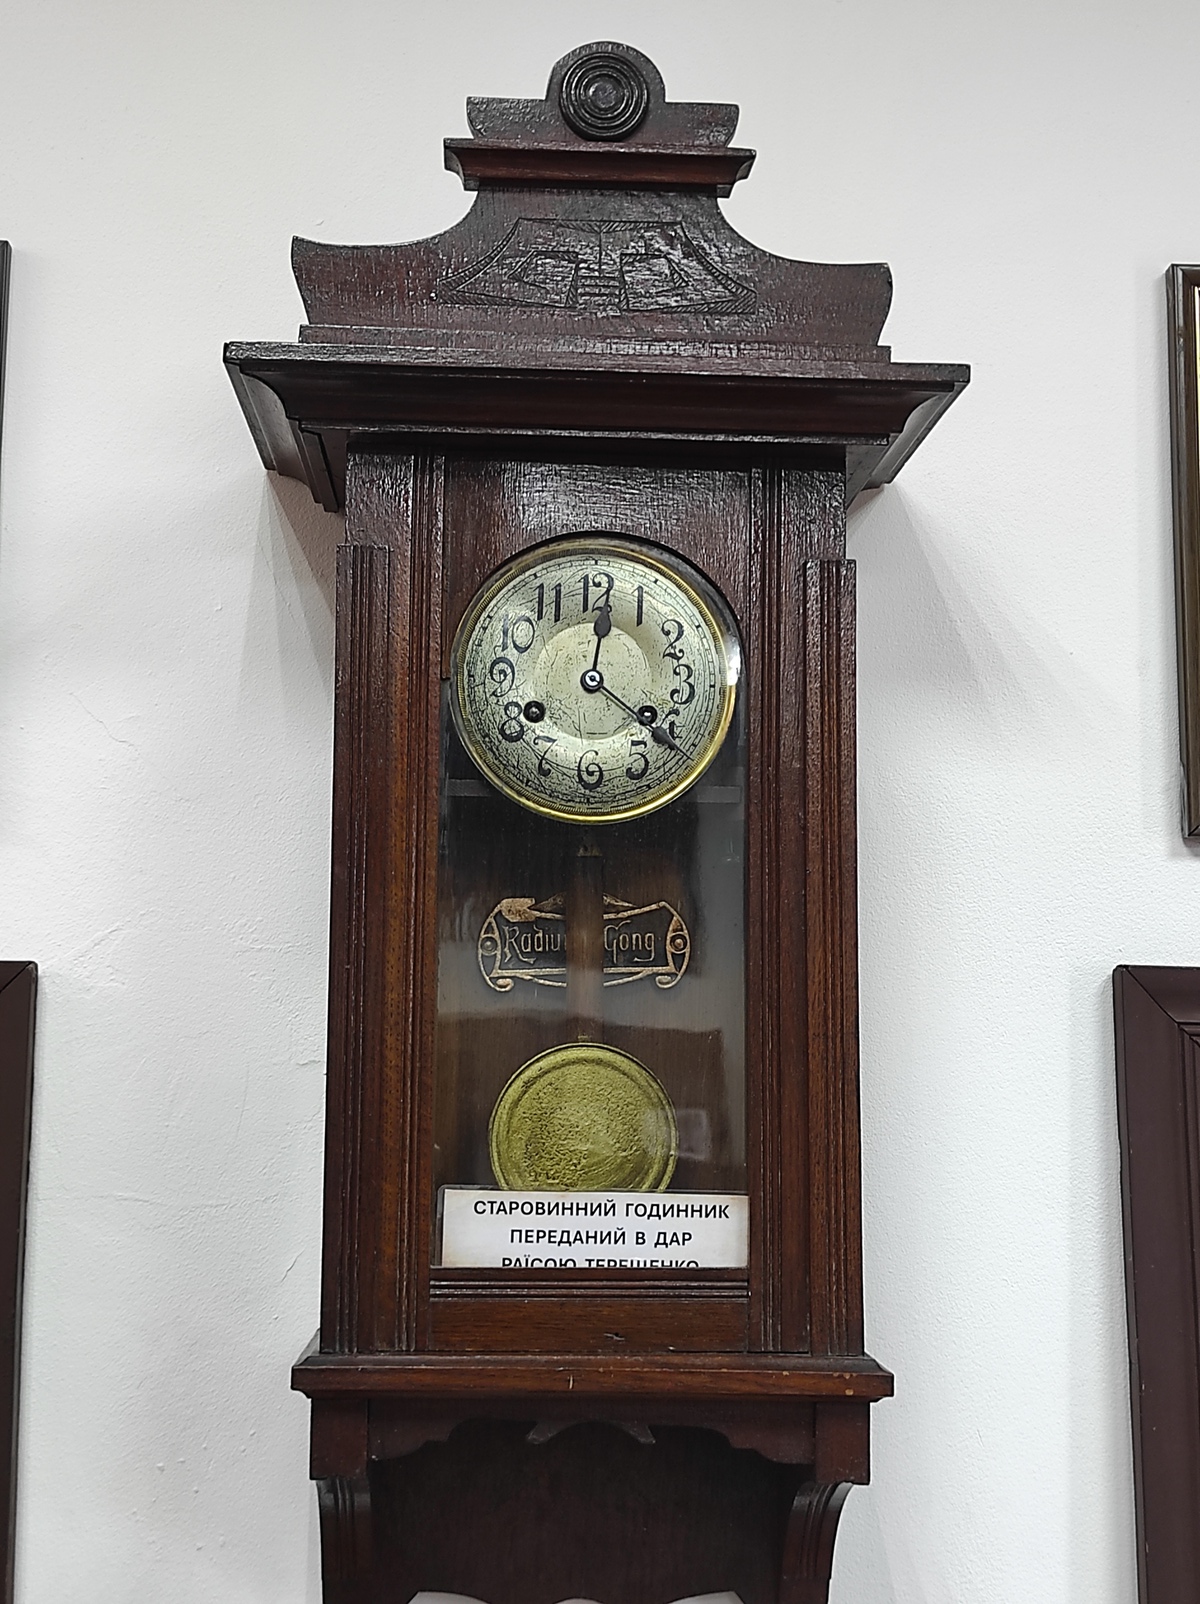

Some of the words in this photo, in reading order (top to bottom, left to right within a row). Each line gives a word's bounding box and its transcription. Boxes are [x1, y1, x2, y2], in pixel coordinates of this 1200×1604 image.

[534, 582, 562, 622] 11
[579, 572, 614, 614] 12
[631, 585, 643, 627] 1
[501, 614, 536, 653] 10
[661, 619, 685, 661] 2
[489, 656, 515, 697] 9
[669, 664, 695, 705] 3
[500, 701, 524, 742] 8
[533, 735, 557, 776] 7
[577, 749, 603, 790] 6
[625, 740, 649, 780] 5
[502, 924, 566, 964] Radiu
[603, 920, 655, 962] Gong
[473, 1199, 616, 1217] СТАРОВИННИЙ
[625, 1203, 730, 1220] ГОДИННИК
[510, 1227, 626, 1247] ПЕРЕДАНИЙ
[635, 1231, 647, 1246] В
[653, 1231, 693, 1248] ДАР
